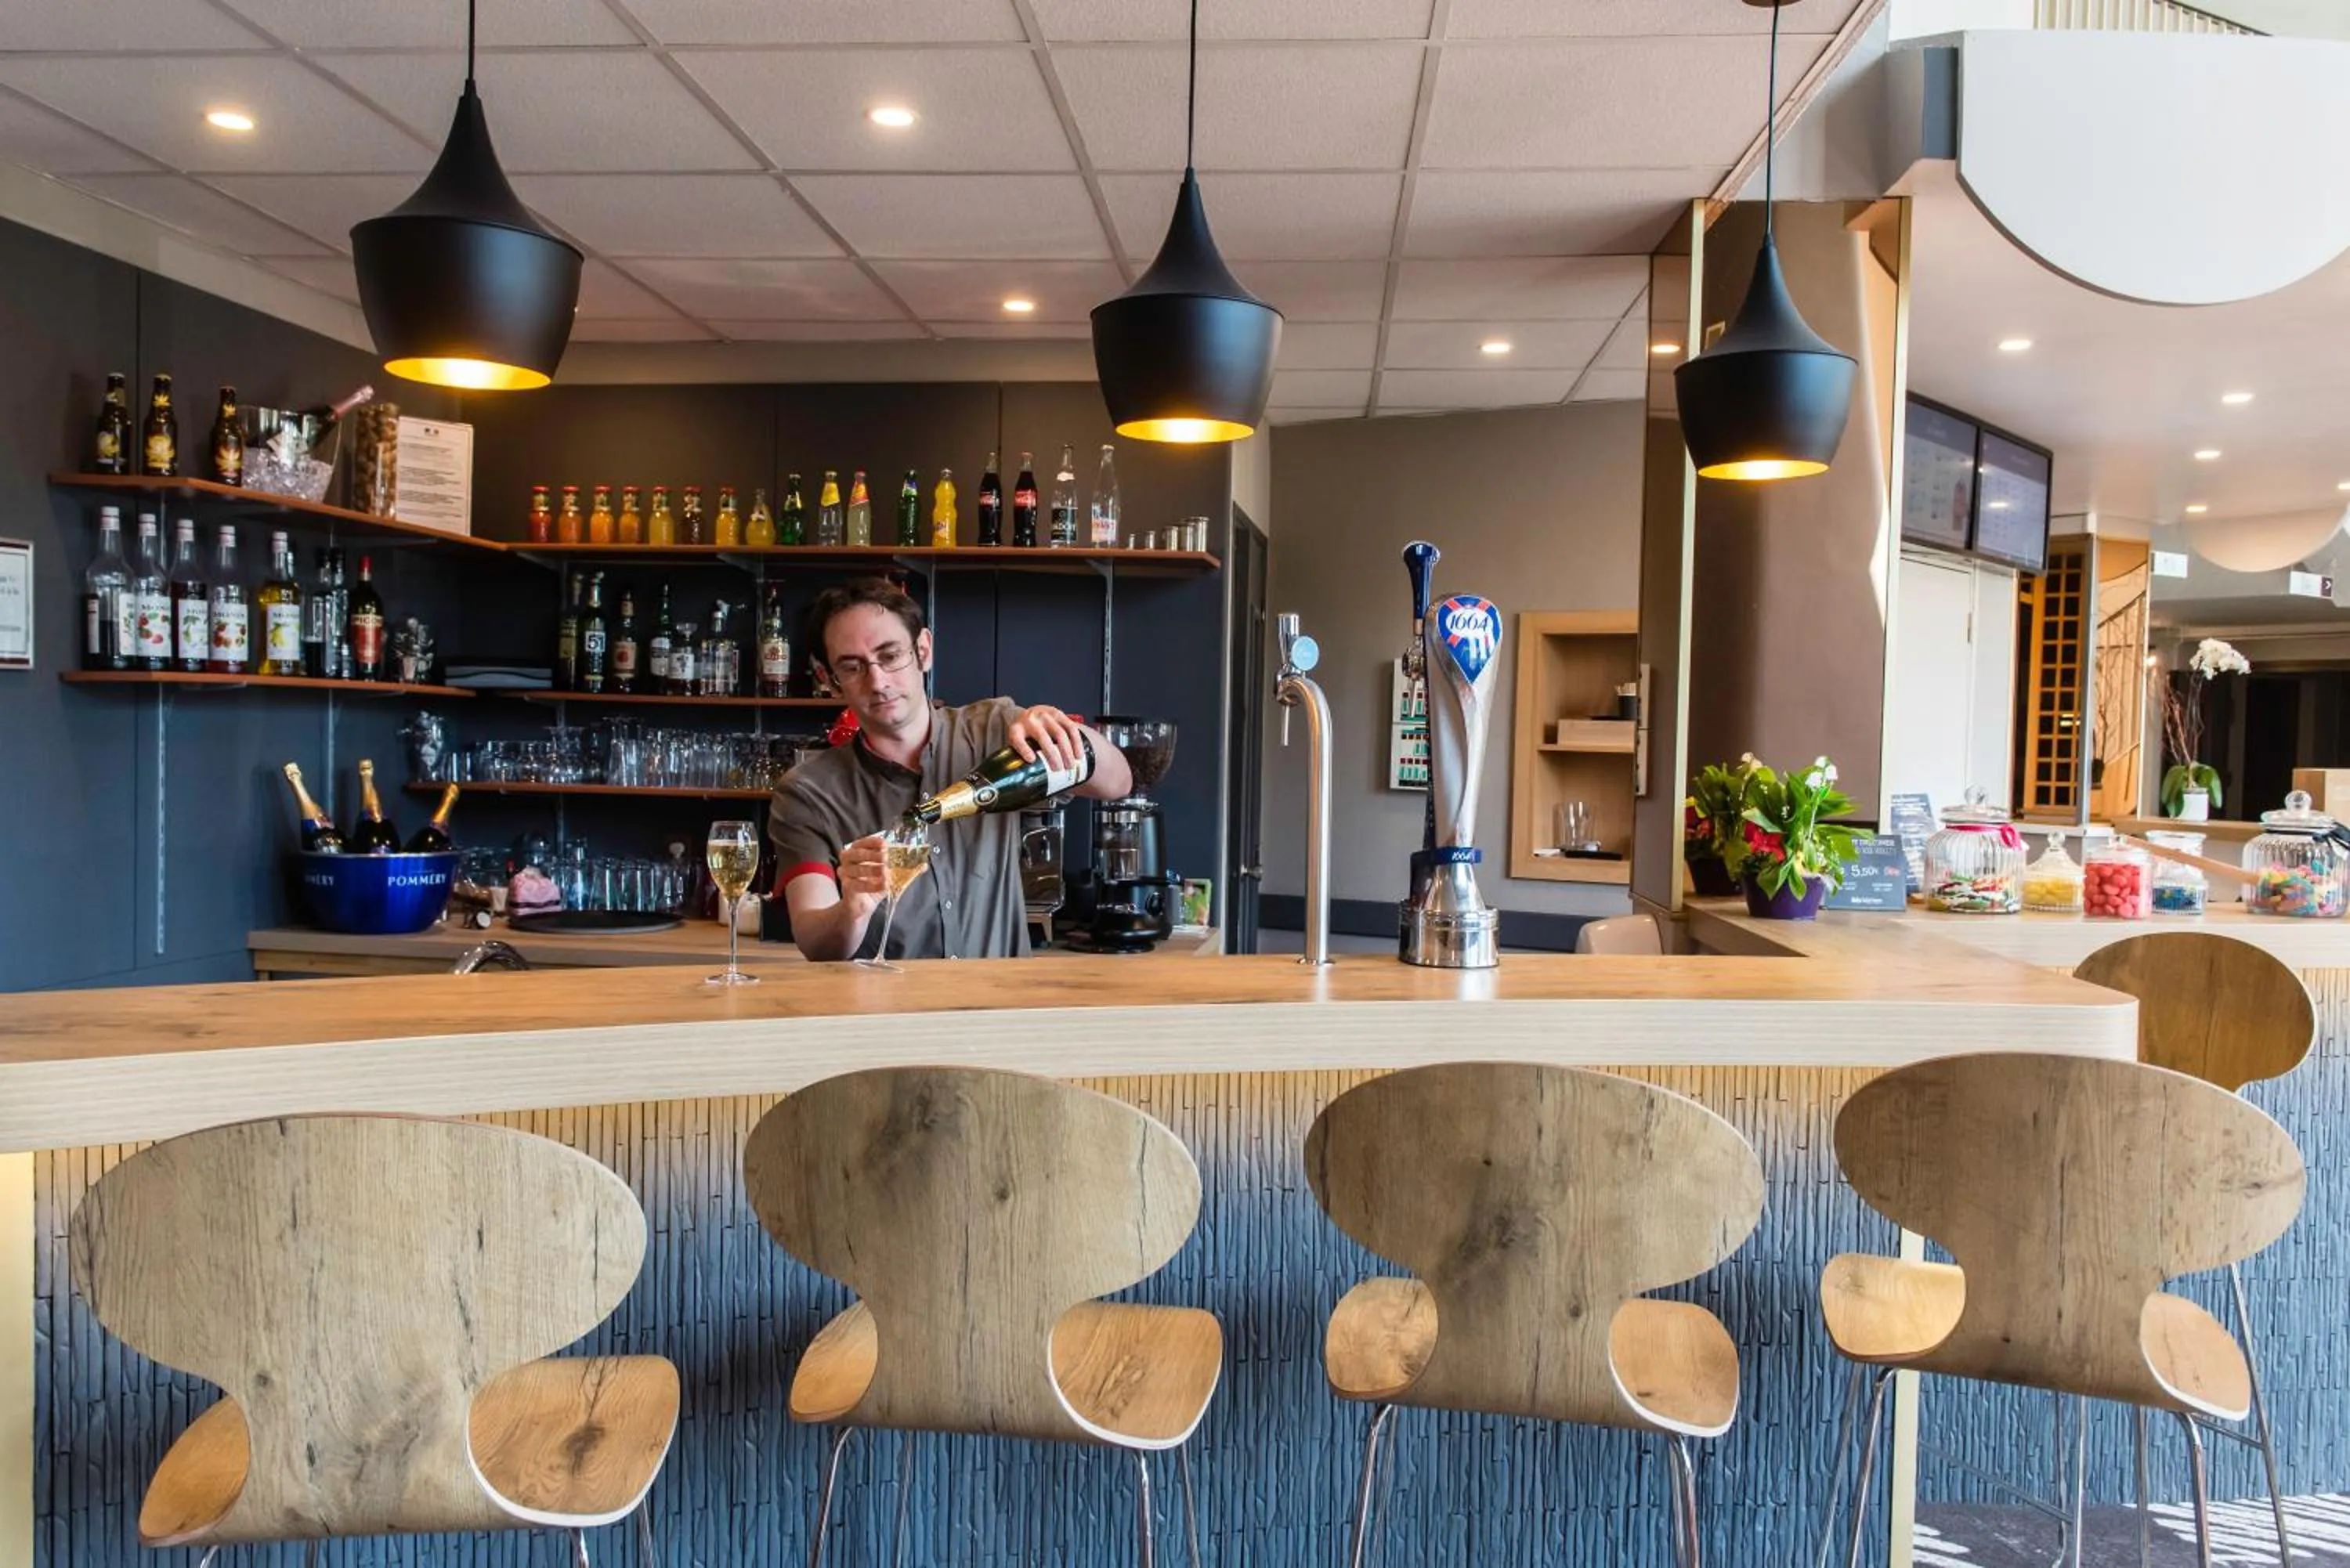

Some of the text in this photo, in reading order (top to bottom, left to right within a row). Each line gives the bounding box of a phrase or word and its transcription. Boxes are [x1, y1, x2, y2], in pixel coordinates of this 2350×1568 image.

[1450, 612, 1489, 631] 1664
[588, 635, 604, 651] 51
[387, 873, 447, 887] POMMERY
